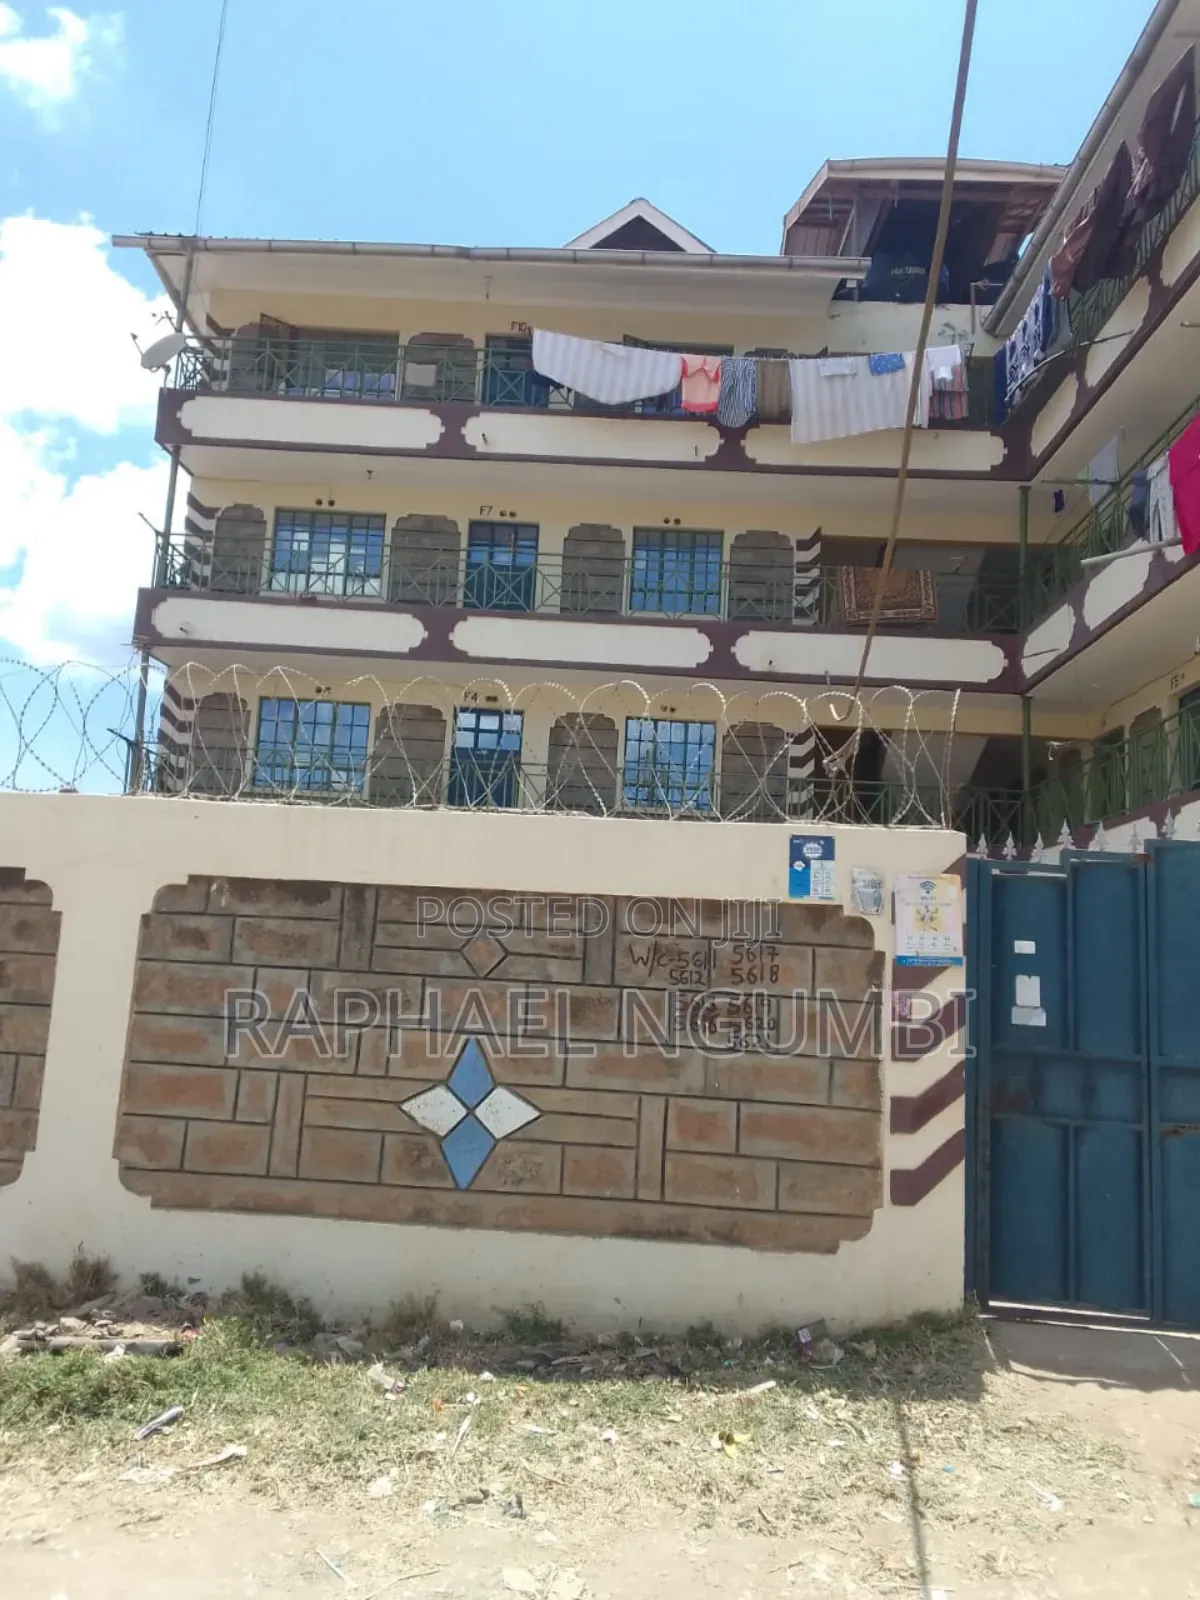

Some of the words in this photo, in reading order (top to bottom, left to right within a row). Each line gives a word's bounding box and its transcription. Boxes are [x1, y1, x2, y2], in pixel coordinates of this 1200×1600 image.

[479, 505, 493, 517] F7
[464, 690, 479, 705] F4
[731, 944, 780, 966] 5617
[669, 968, 706, 986] 5612
[730, 964, 780, 986] 5618
